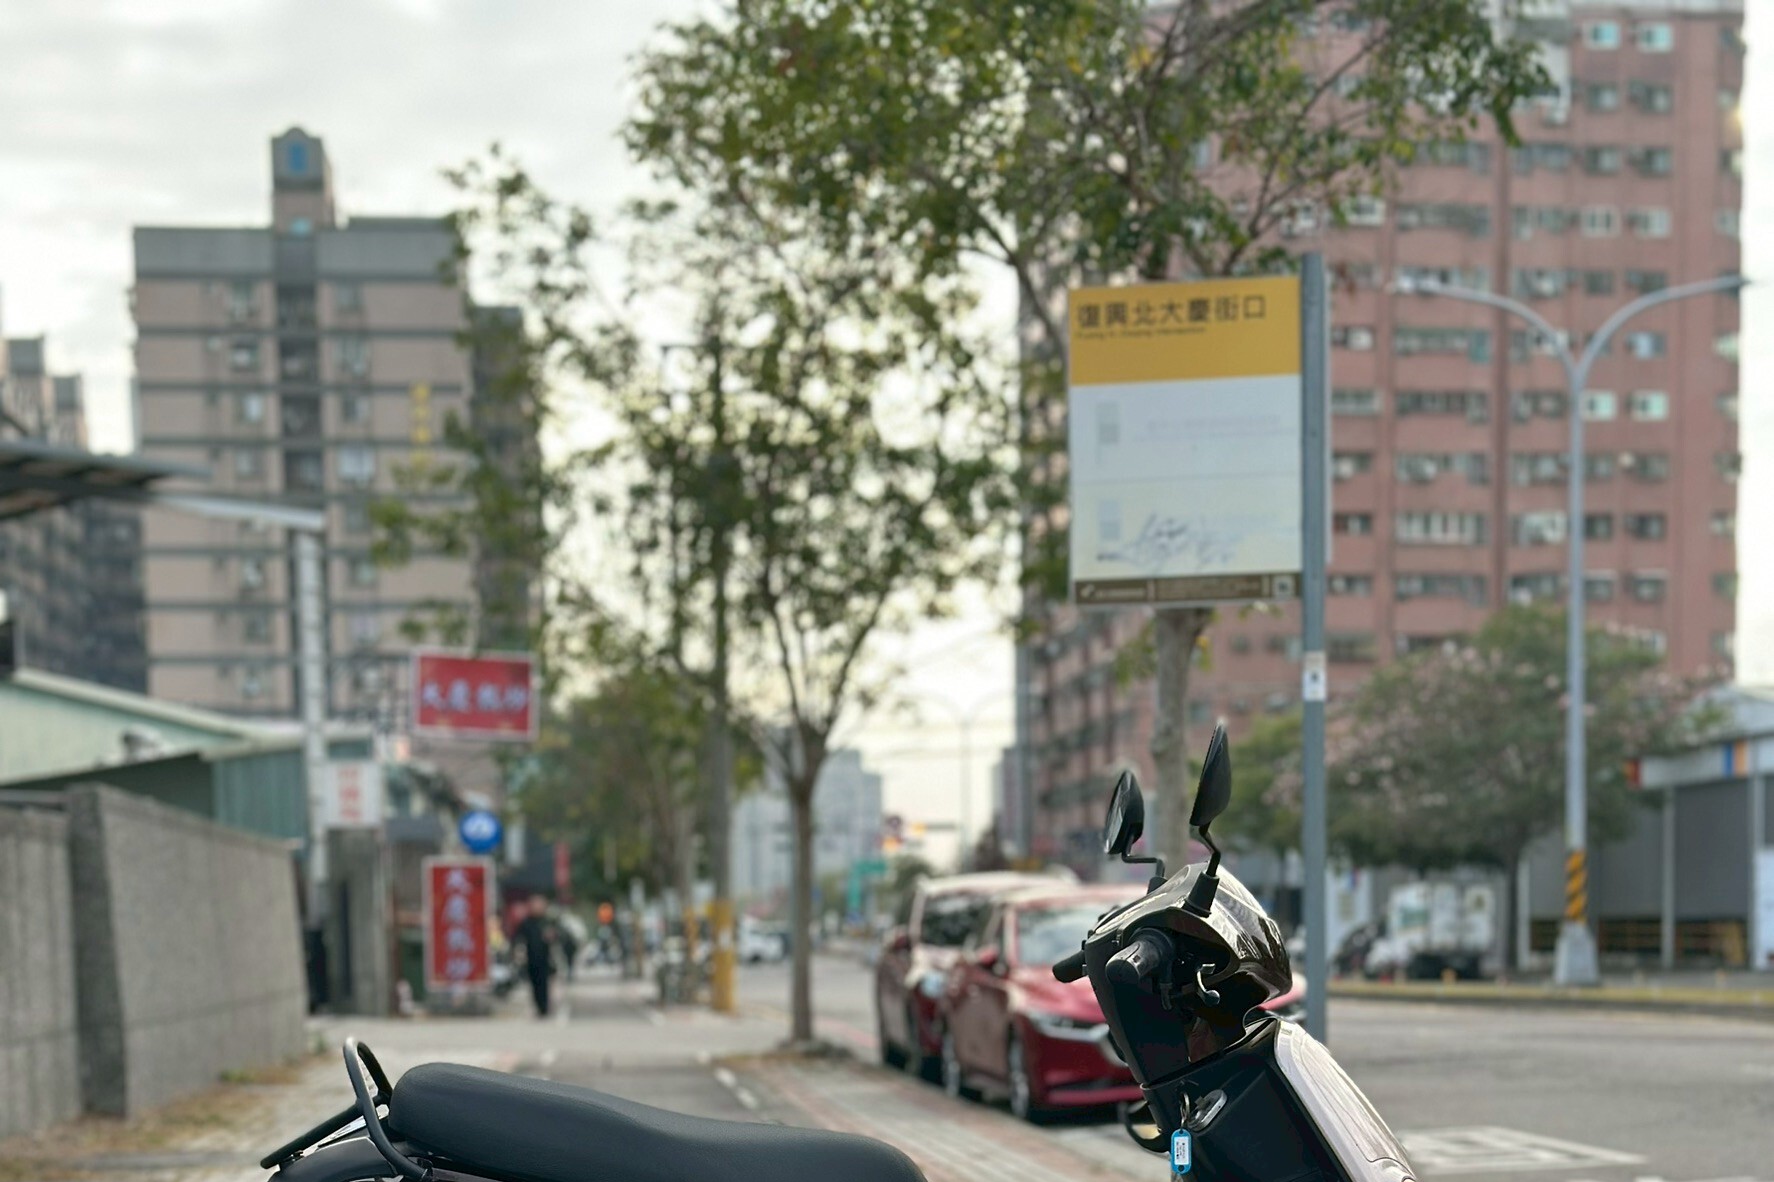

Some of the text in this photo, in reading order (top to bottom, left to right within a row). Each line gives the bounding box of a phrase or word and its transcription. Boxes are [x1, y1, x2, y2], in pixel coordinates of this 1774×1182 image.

[1077, 295, 1267, 329] 復興北大慶街口
